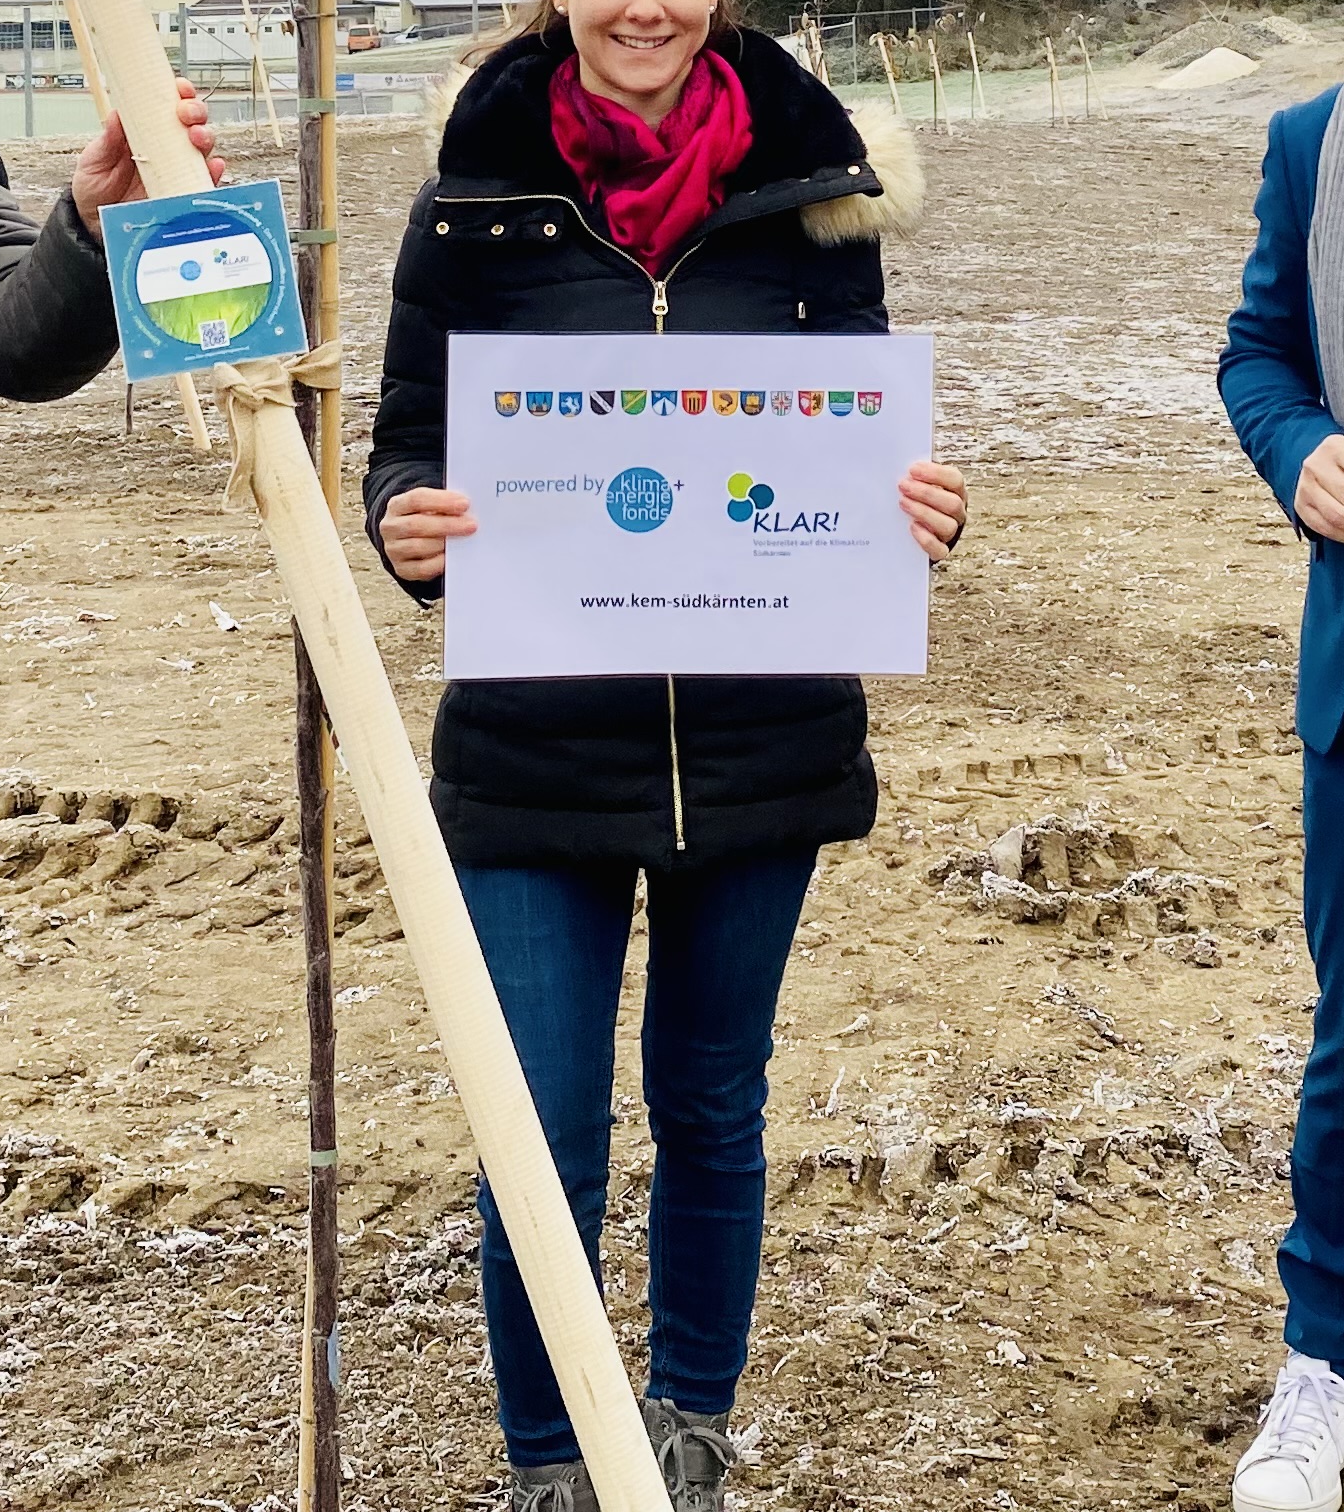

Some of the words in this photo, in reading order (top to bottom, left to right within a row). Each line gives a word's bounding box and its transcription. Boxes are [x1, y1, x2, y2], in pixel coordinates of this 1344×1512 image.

[495, 474, 577, 498] powered
[583, 474, 605, 496] by
[619, 474, 669, 493] klima
[606, 489, 671, 509] energie
[622, 503, 670, 521] fonds
[753, 511, 840, 533] KLAR!
[799, 538, 813, 547] auf
[815, 538, 827, 547] die
[579, 592, 790, 609] www.kem-südkärnten.at
